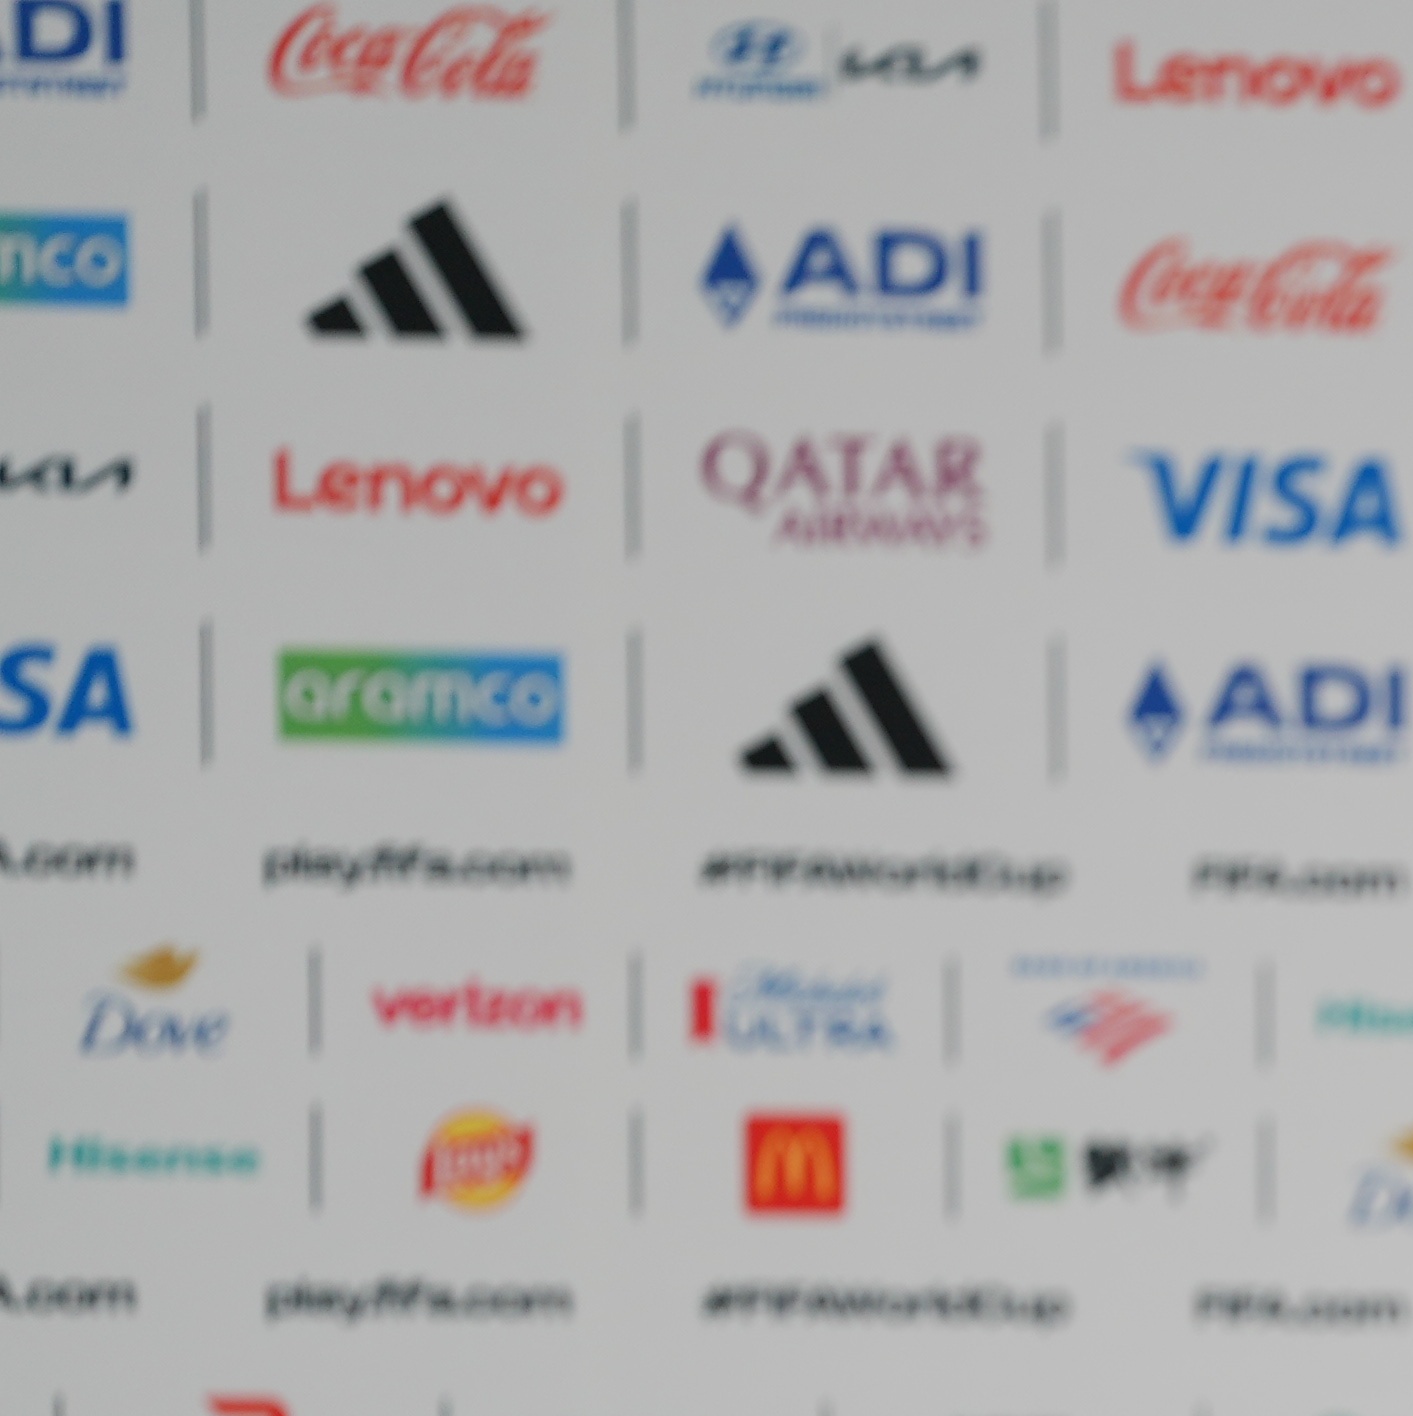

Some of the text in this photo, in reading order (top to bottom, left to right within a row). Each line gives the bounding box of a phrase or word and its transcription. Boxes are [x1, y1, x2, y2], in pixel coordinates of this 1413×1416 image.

[0, 0, 125, 63] DI
[1113, 41, 1402, 110] Lenovo
[780, 226, 984, 295] ADI
[272, 448, 565, 518] Lenovo
[698, 431, 987, 513] QATAR
[1143, 452, 1402, 547] VISA
[284, 662, 557, 729] aramco
[1205, 662, 1408, 730] ADI
[0, 838, 136, 878] .com
[79, 993, 229, 1055] Dove
[371, 980, 584, 1030] verizon
[46, 1135, 261, 1177] Hisense
[0, 1273, 138, 1314] .com
